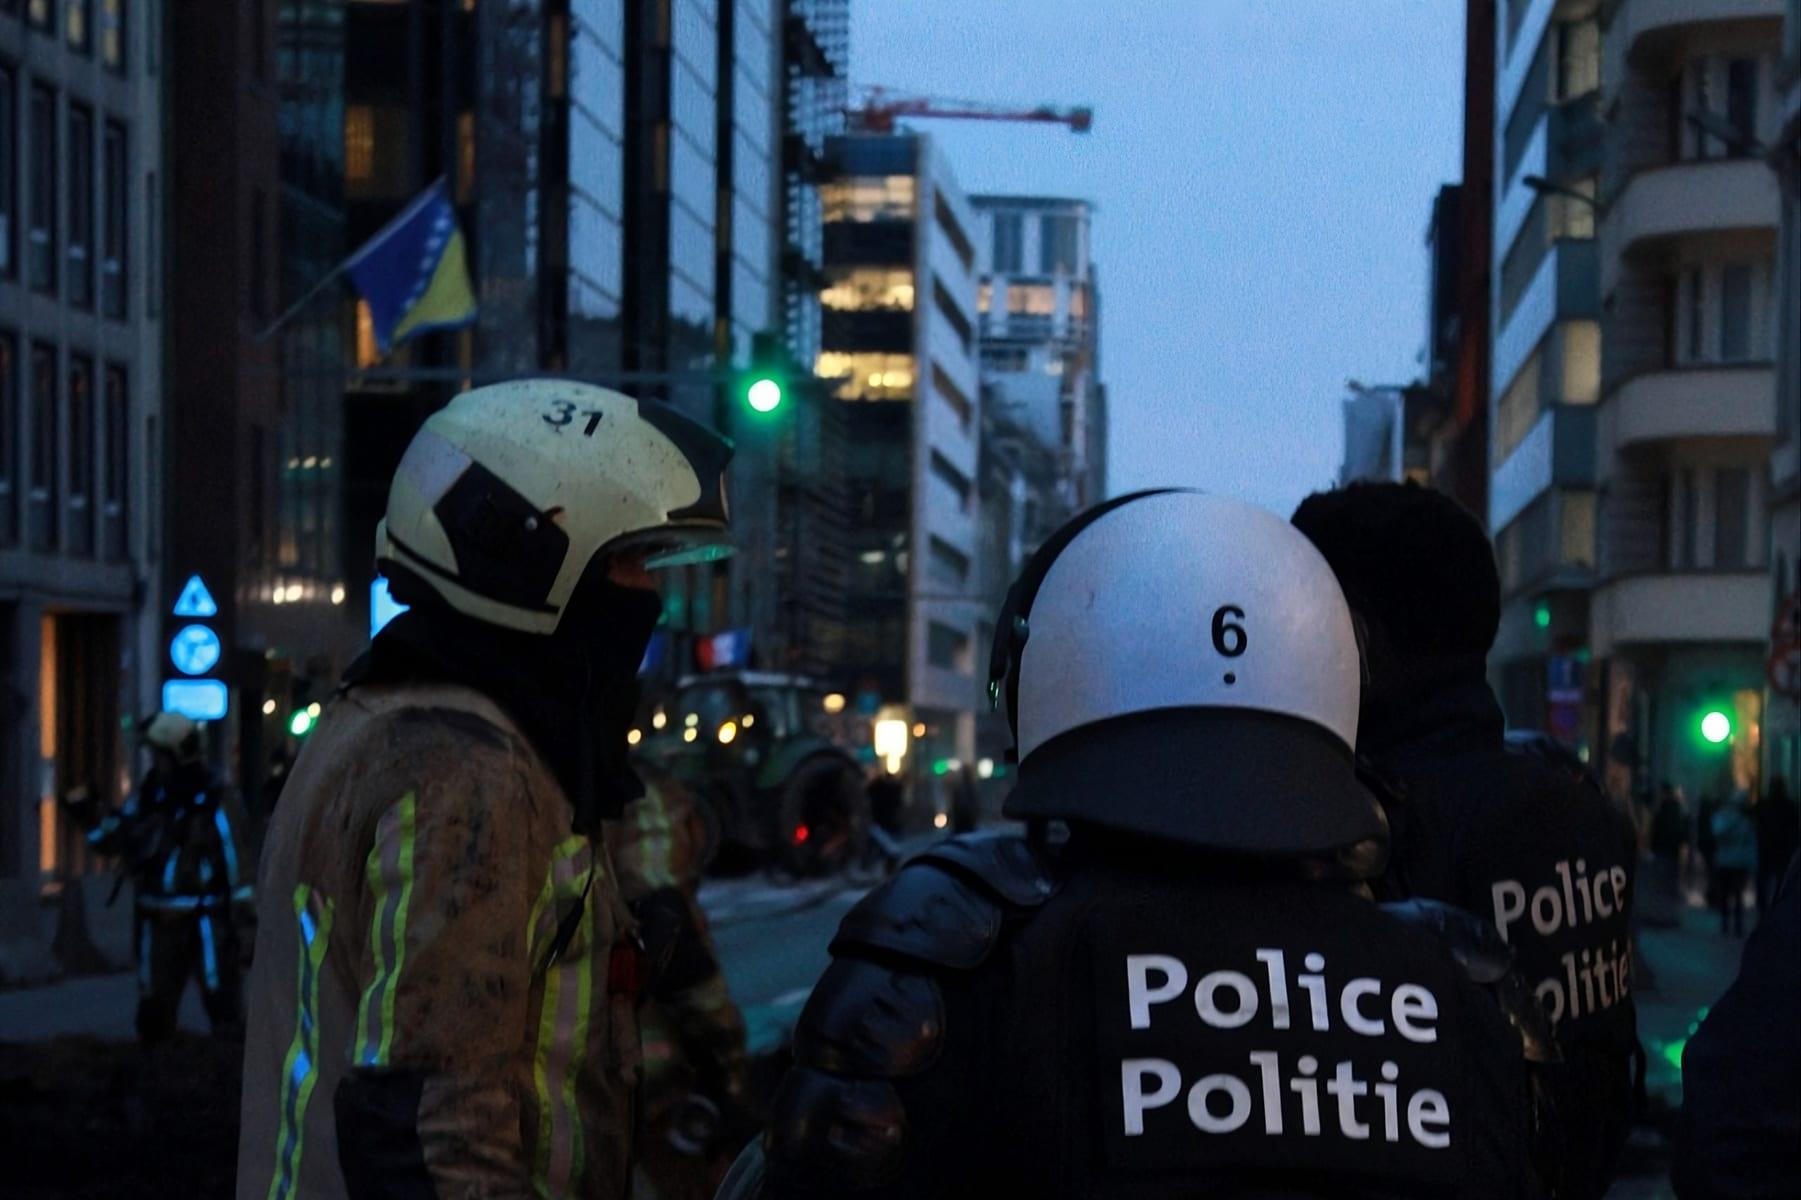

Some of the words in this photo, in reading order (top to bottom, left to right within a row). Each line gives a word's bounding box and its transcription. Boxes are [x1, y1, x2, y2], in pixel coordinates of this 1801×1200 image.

[541, 399, 604, 437] 31
[1211, 604, 1248, 658] 6
[1491, 857, 1627, 945] Police
[1126, 947, 1439, 1044] Police
[1534, 938, 1629, 1025] olitie
[1121, 1050, 1451, 1149] Politie
